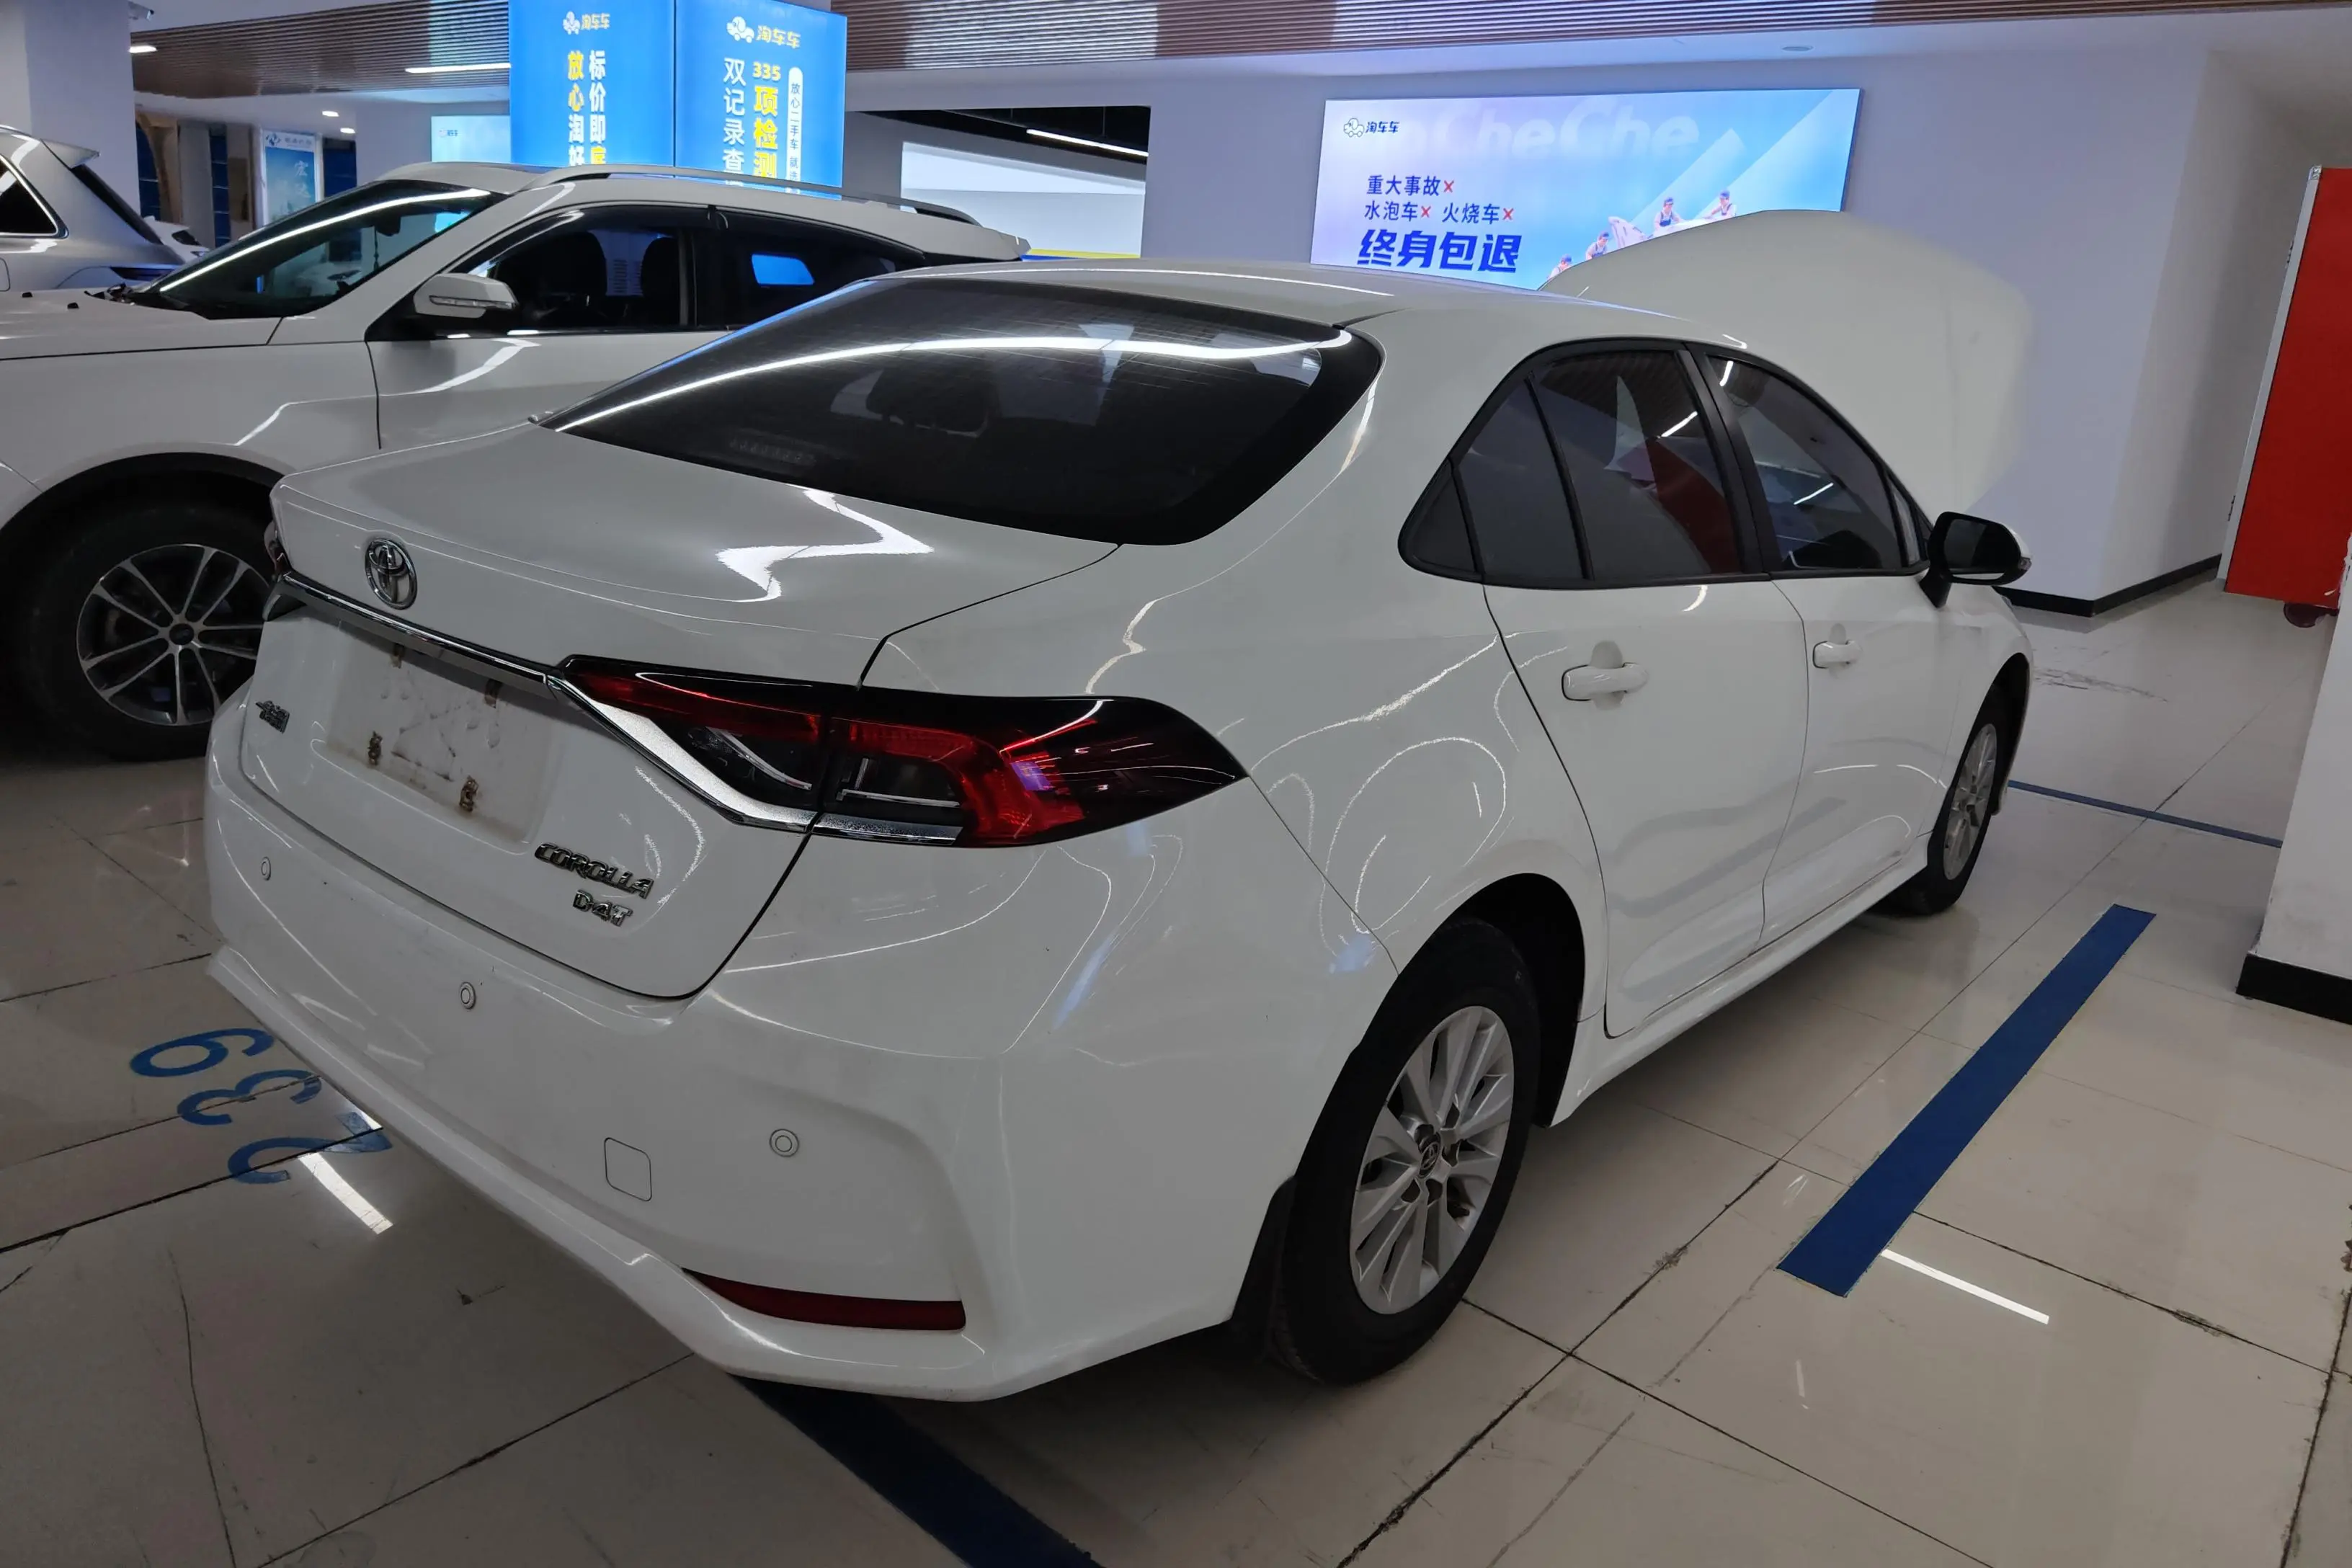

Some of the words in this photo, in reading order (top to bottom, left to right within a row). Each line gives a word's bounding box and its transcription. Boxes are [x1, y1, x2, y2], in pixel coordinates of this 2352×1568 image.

[757, 25, 801, 48] 淘车车
[1365, 121, 1400, 134] 淘车车
[1366, 174, 1441, 197] 重大事故
[1364, 200, 1419, 223] 水泡车
[1441, 202, 1500, 225] 火烧车
[1357, 228, 1523, 274] 终身包退
[534, 842, 655, 900] COROLLA
